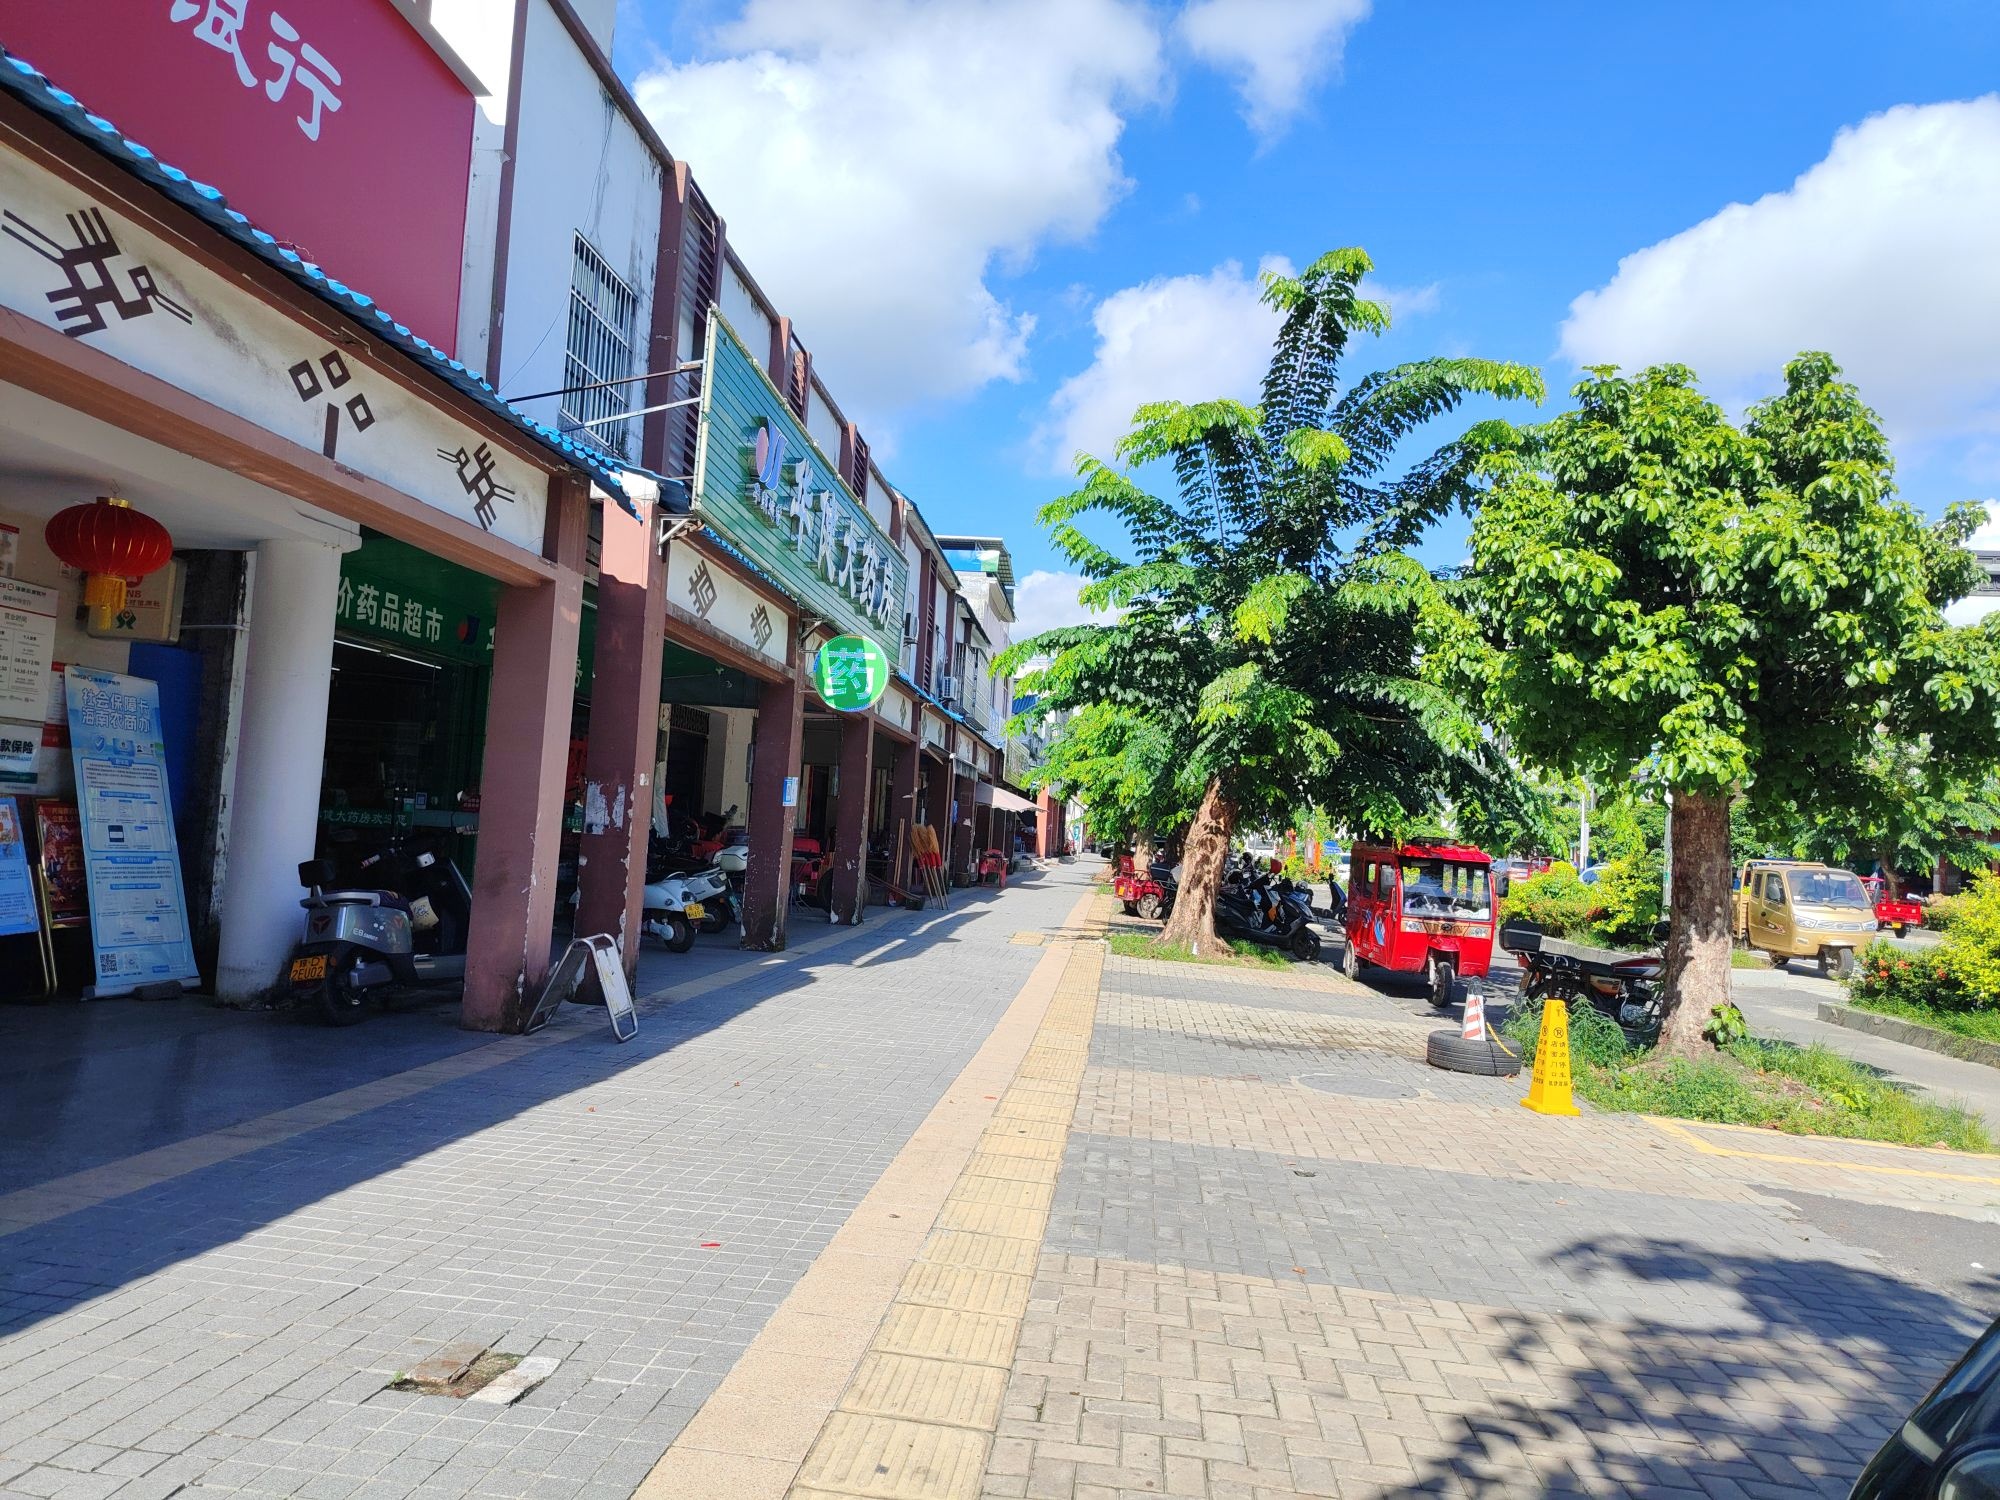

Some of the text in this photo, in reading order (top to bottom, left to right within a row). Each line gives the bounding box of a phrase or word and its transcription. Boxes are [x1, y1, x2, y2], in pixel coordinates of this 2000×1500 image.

[336, 576, 444, 643] 价药品超市
[824, 647, 876, 700] 药
[82, 688, 149, 712] 社会保障卡
[82, 706, 151, 733] 海南农商办
